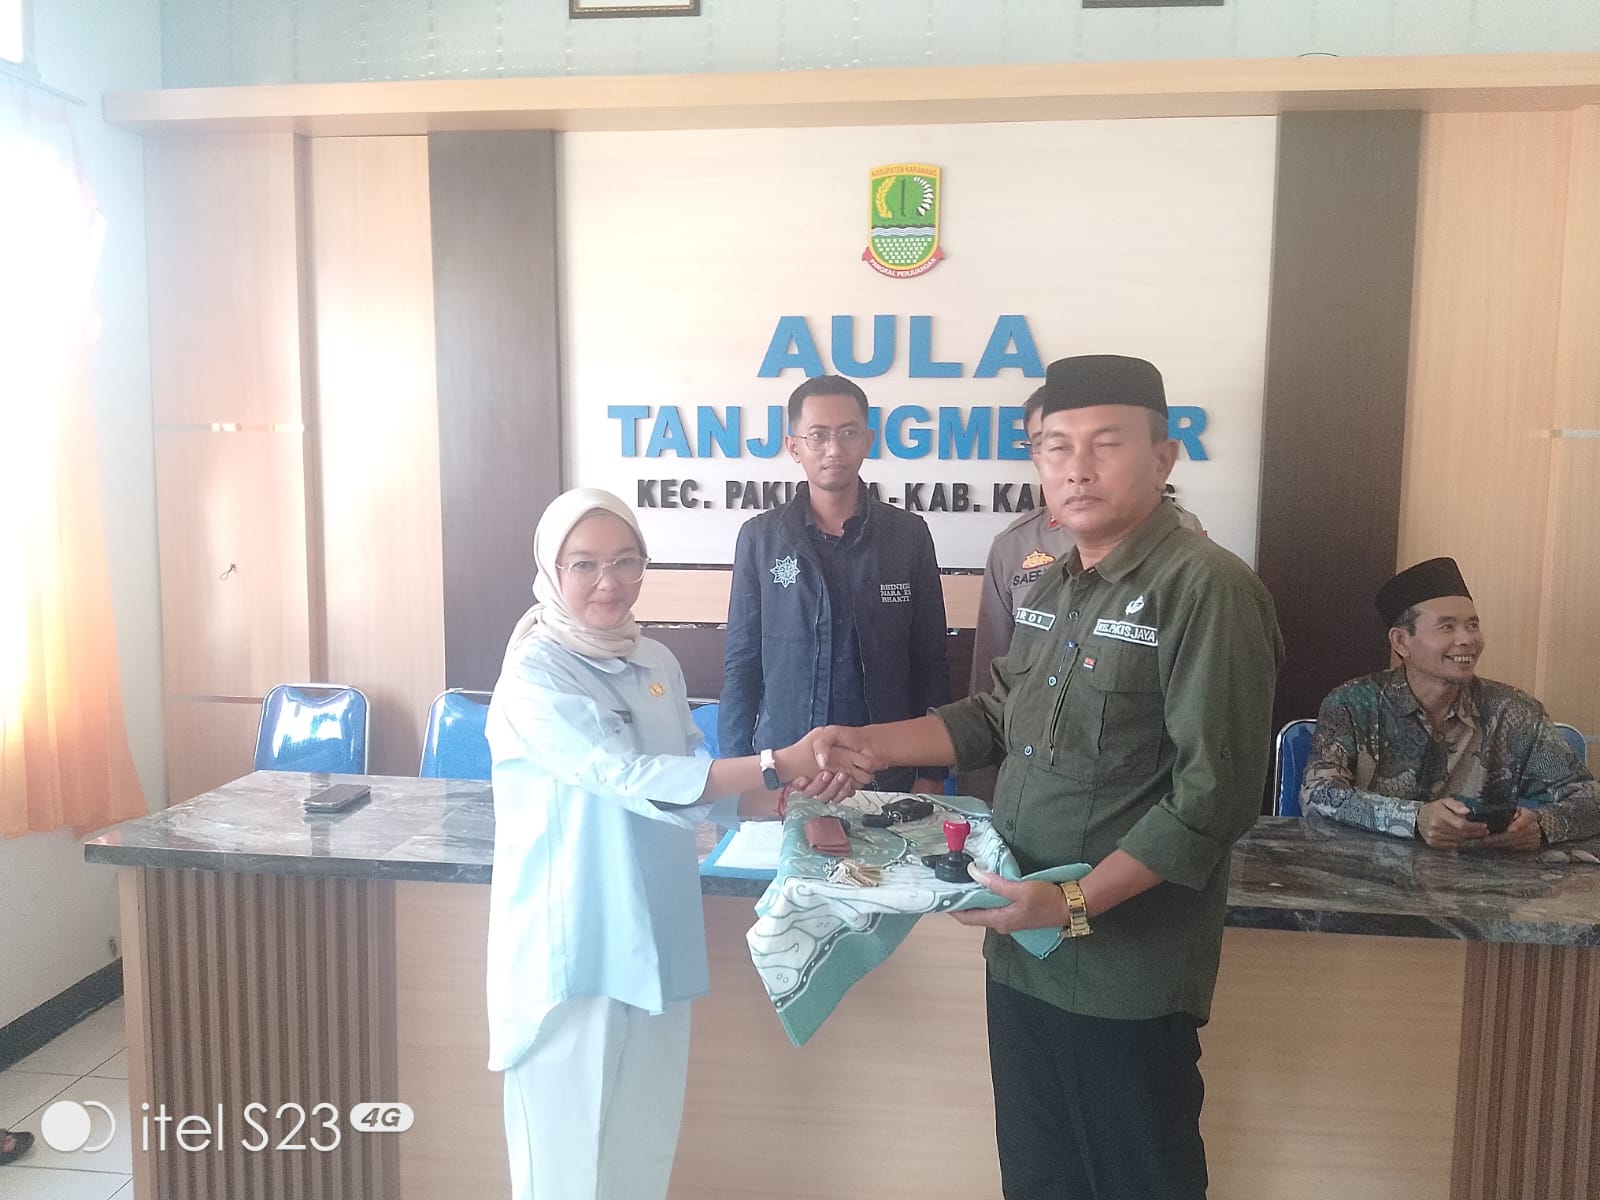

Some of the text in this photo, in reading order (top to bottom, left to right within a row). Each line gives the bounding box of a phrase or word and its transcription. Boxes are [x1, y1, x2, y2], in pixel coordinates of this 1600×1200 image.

[757, 314, 1047, 379] AULA
[607, 404, 1209, 461] TANJGMER
[637, 478, 712, 509] KEC.
